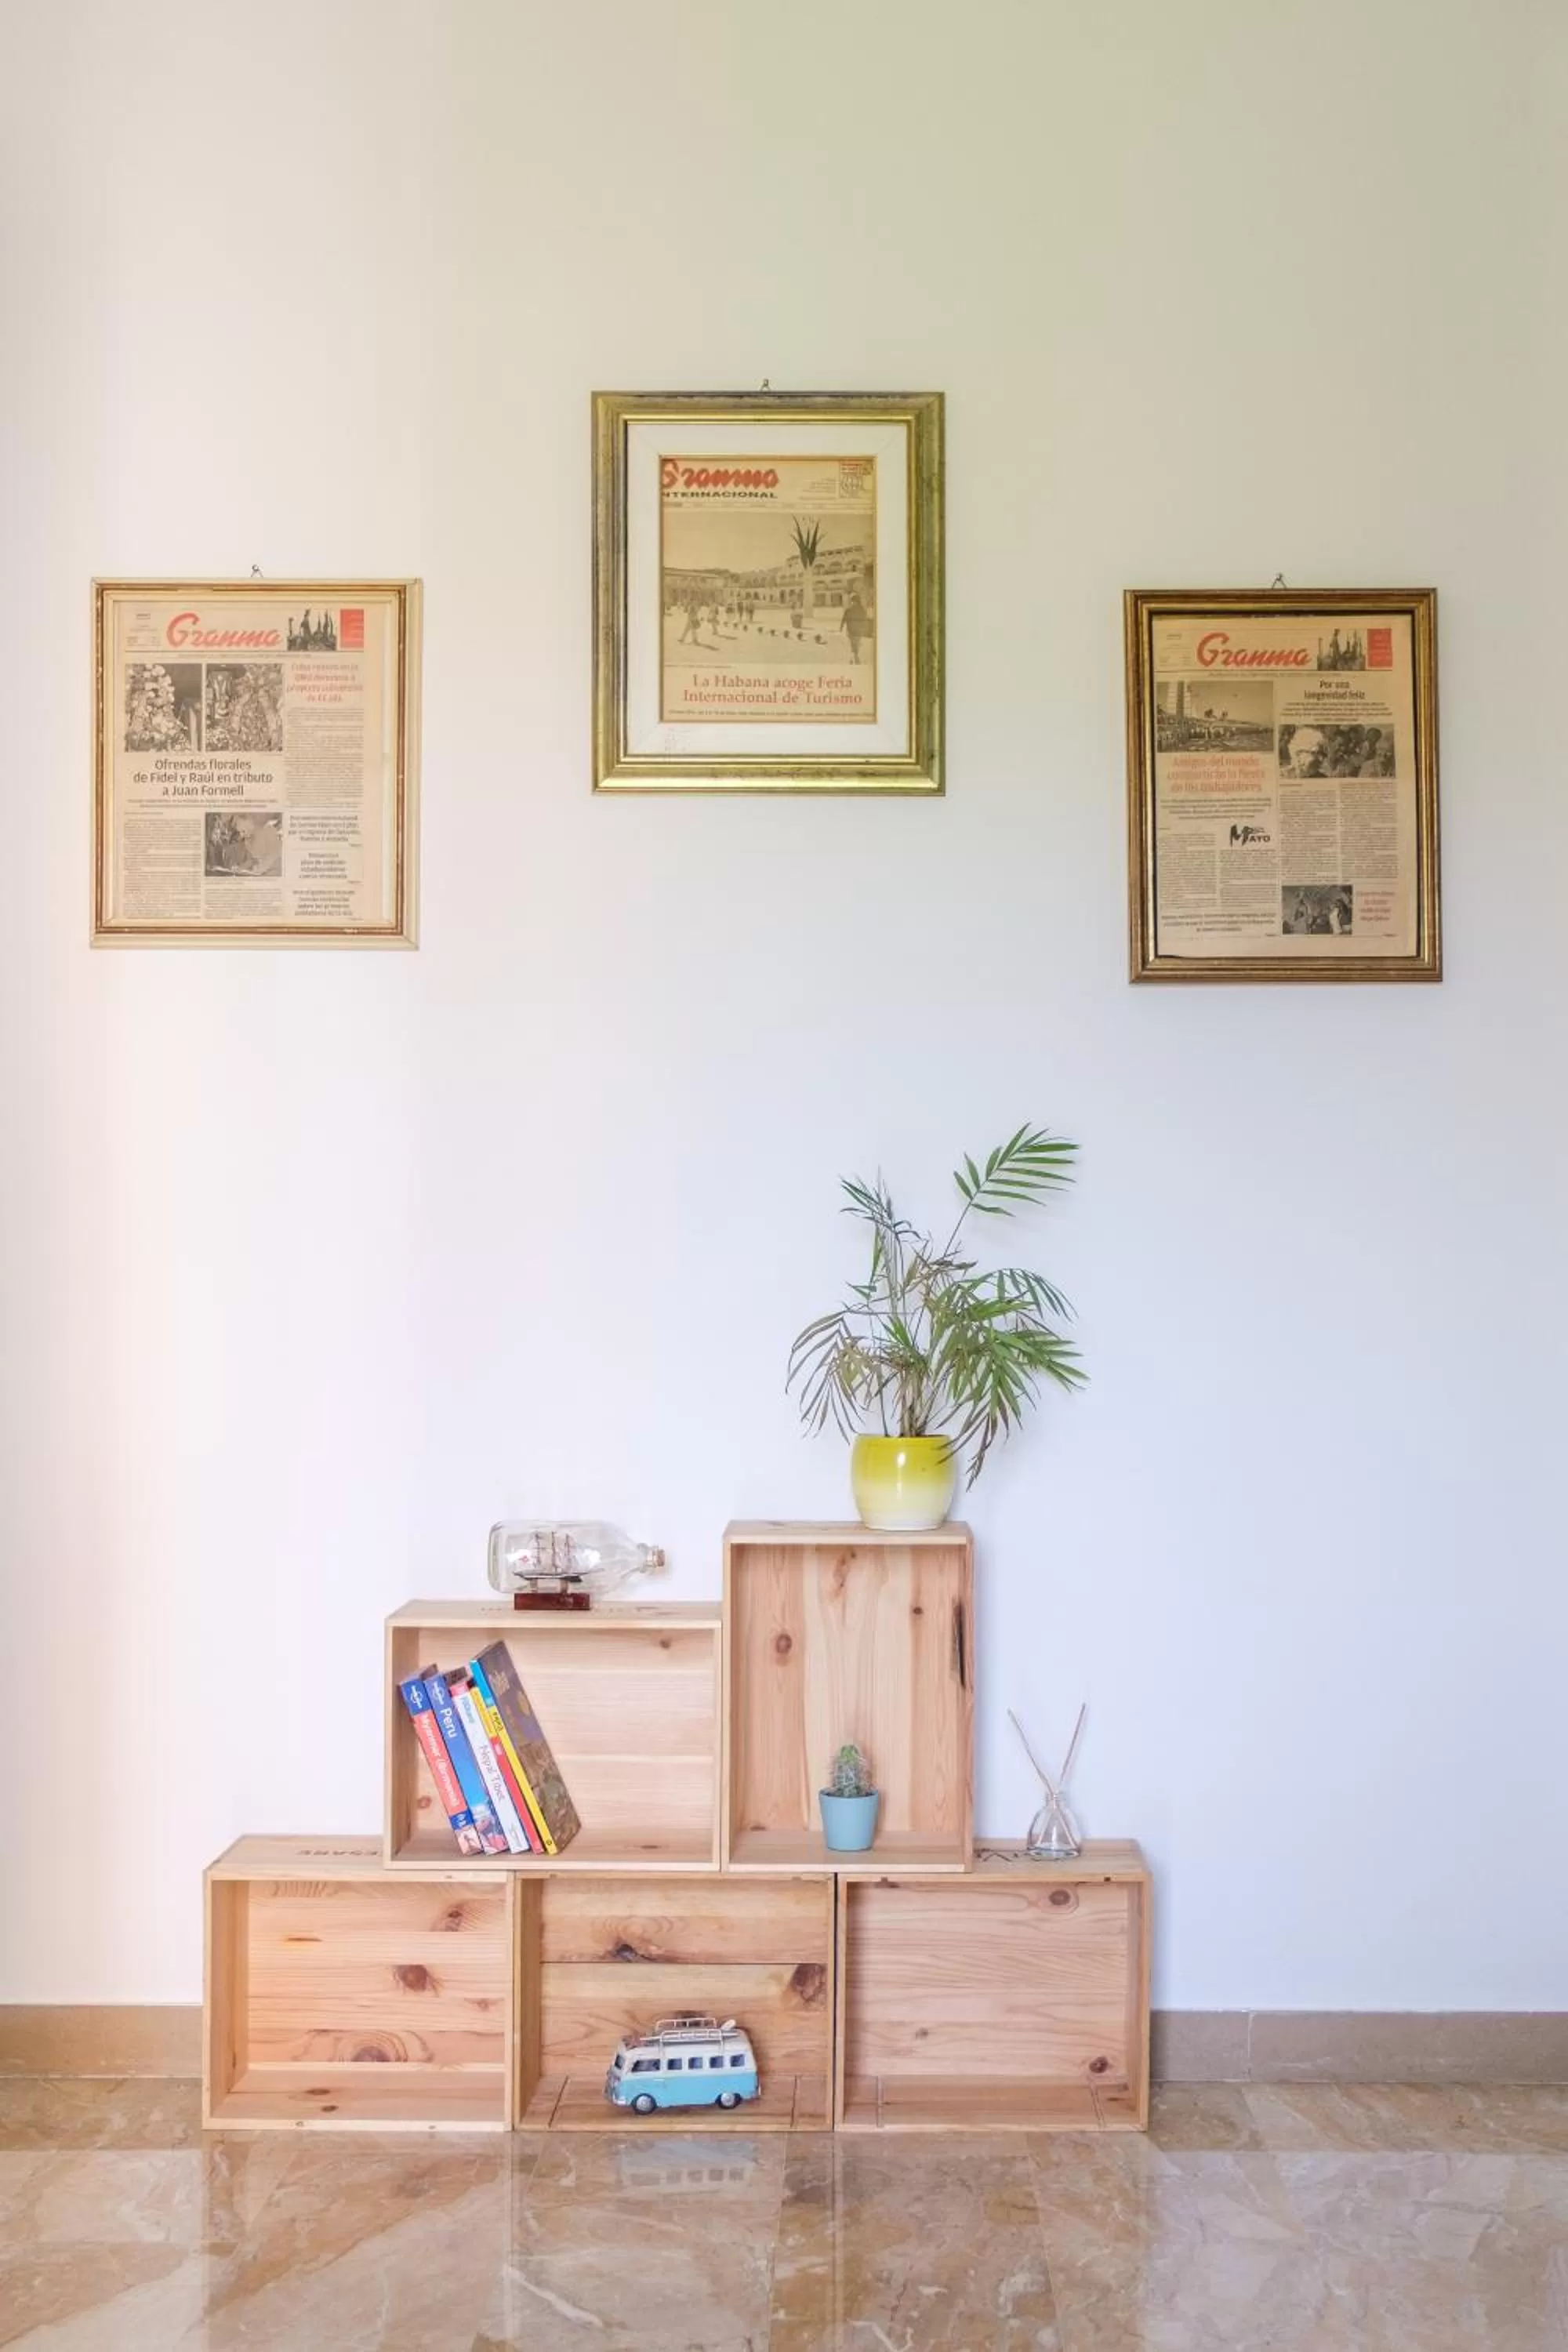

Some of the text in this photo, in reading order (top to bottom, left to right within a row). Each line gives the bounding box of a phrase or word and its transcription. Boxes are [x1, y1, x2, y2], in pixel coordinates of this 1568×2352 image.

[662, 490, 778, 499] NTERNACIONAL
[165, 612, 282, 648] Granma
[1196, 632, 1312, 667] Granma
[692, 673, 853, 694] La Habana acoge Feria
[683, 689, 862, 705] Internacional de Turismo
[154, 757, 252, 771] Ofrendas florales
[132, 771, 274, 785] de Fidel y Raúl en tributo
[162, 784, 245, 797] a Juan Formell
[440, 1707, 457, 1738] Peru
